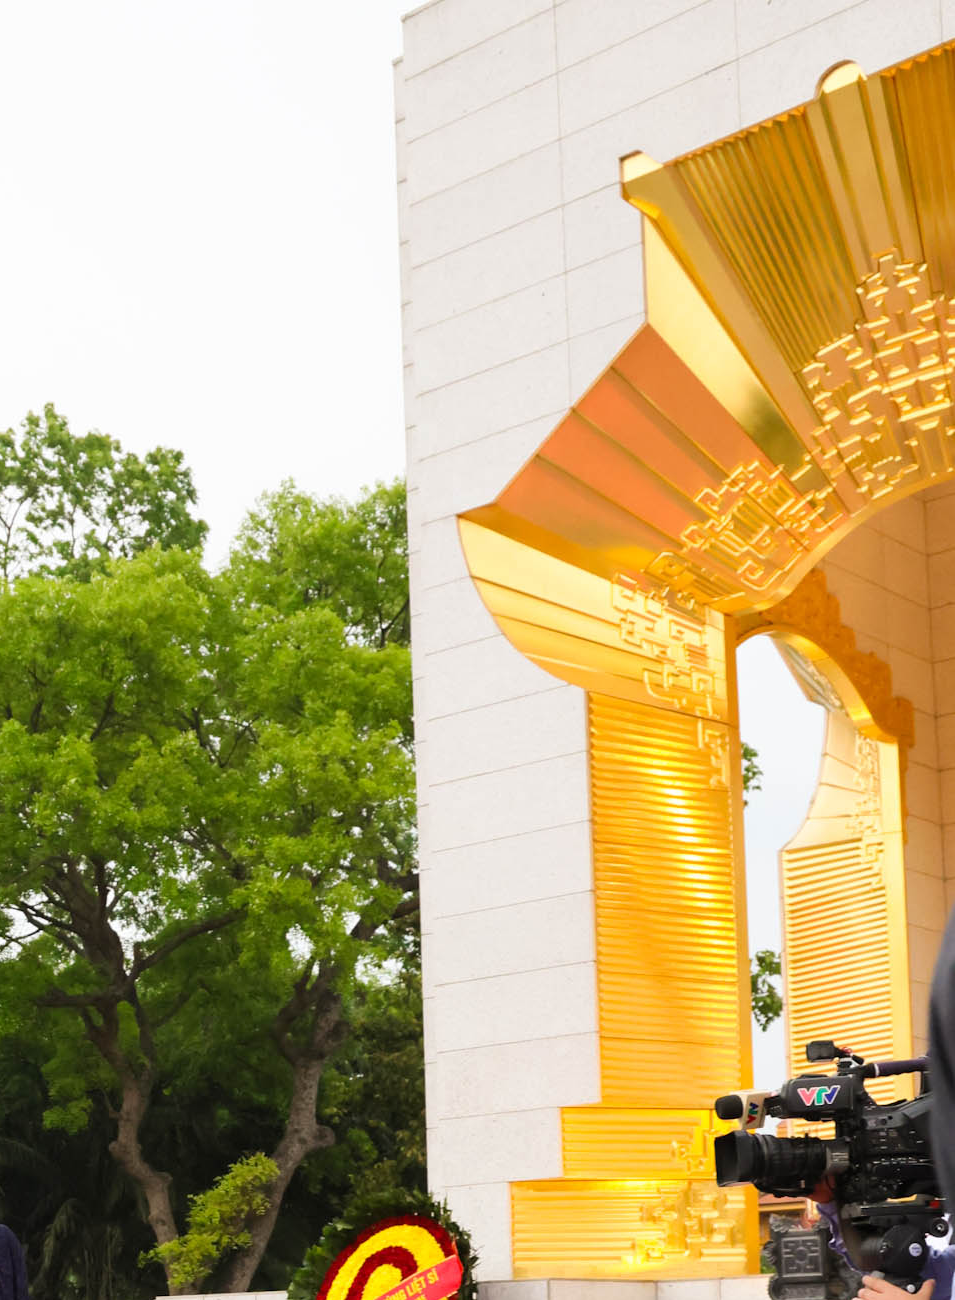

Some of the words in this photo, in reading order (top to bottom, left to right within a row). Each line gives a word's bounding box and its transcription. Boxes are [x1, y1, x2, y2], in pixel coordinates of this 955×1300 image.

[797, 1085, 841, 1107] VTV
[405, 1276, 427, 1297] LIỆT
[427, 1267, 440, 1285] SĨ
